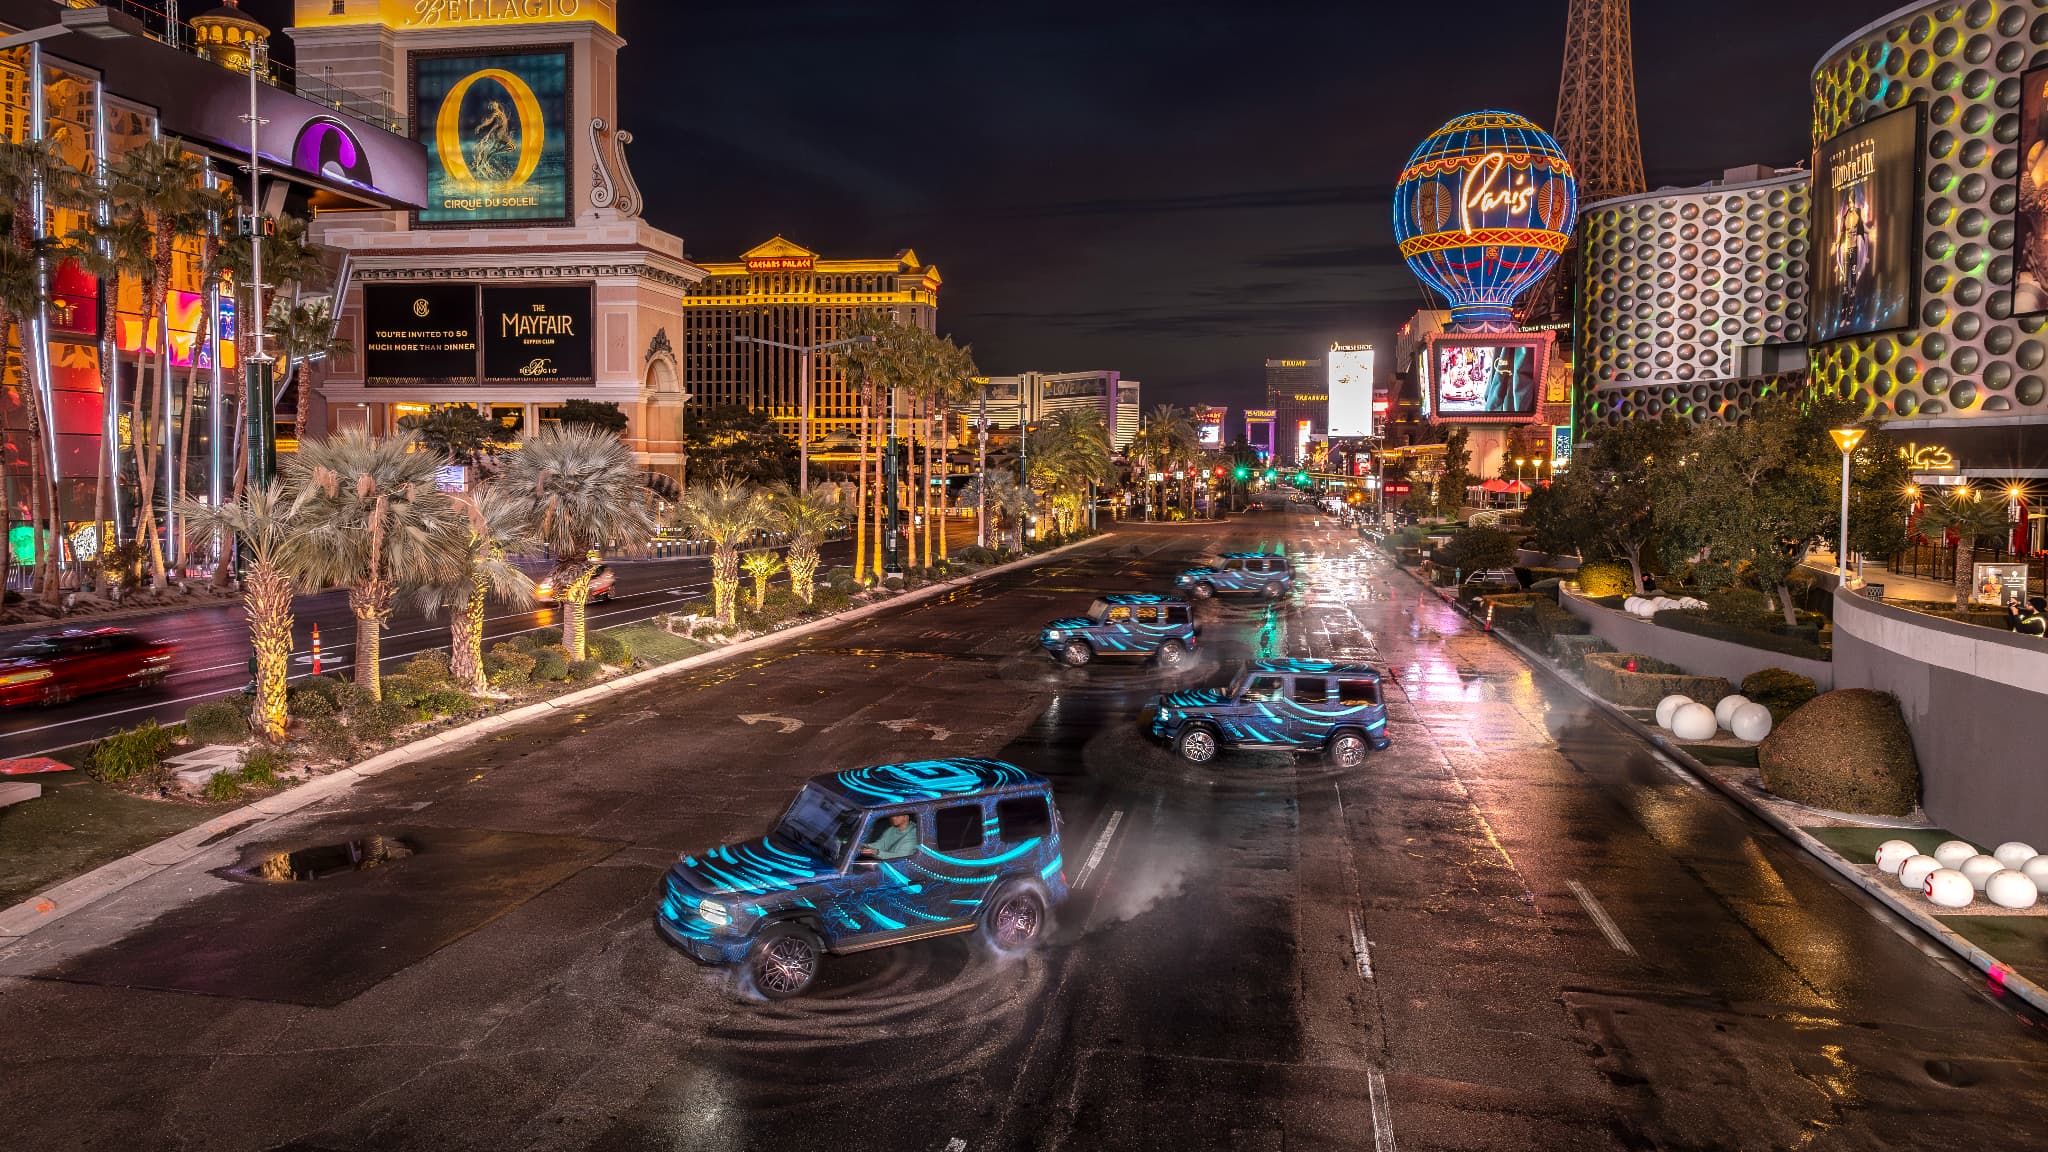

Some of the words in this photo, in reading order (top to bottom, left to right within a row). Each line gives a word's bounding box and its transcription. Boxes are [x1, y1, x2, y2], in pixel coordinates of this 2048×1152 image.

[406, 0, 579, 25] BELLAGIO
[1461, 152, 1535, 235] Paris
[444, 199, 482, 211] CIRQUE
[485, 198, 499, 207] DU
[502, 197, 538, 206] SOLEIL
[749, 260, 780, 268] CAESARS
[783, 259, 811, 268] PALACE
[532, 304, 546, 312] THE
[502, 313, 574, 338] MAYFAIR
[1541, 322, 1570, 331] RESTAURANT
[368, 343, 393, 351] MUCH
[394, 343, 418, 351] MORE
[444, 343, 475, 351] DINNER
[1053, 382, 1076, 395] LOVE
